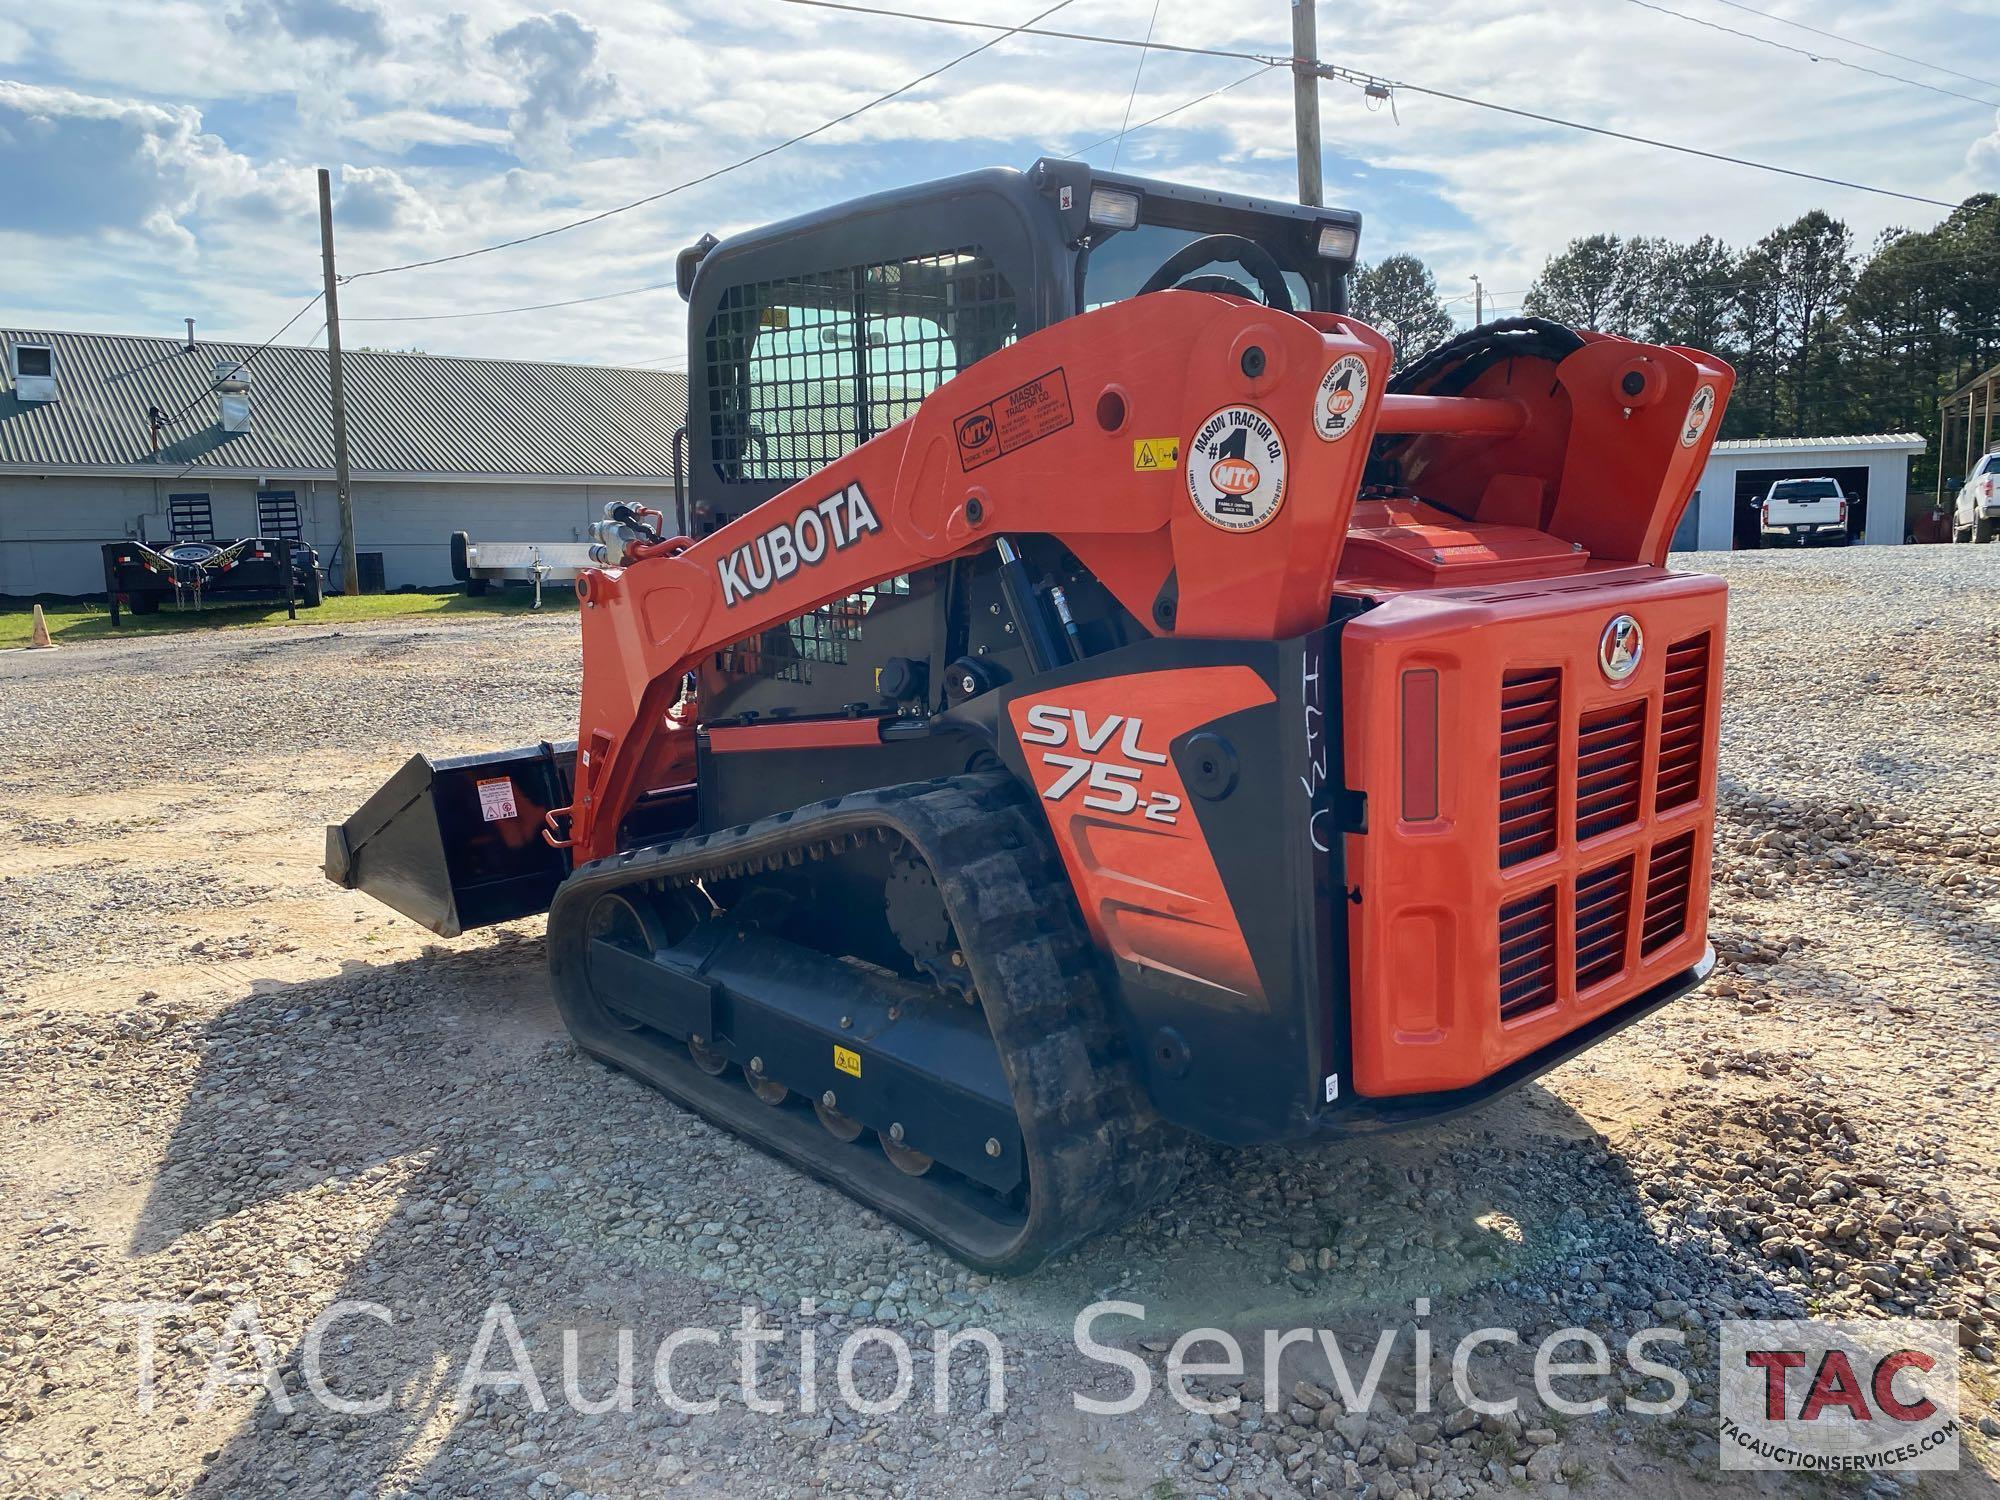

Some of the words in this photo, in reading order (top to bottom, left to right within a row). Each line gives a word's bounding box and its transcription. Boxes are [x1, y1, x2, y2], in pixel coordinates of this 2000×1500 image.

[1009, 382, 1043, 407] MASON
[1005, 398, 1038, 418] TRACTOR
[963, 418, 991, 445] MTC
[1194, 415, 1226, 454] MASON
[1228, 410, 1273, 442] TRACTOR
[1266, 440, 1282, 464] CO.
[1218, 466, 1256, 488] MTC
[1203, 511, 1237, 528] CONSTRUCTION
[214, 548, 237, 564] GATOR
[716, 482, 880, 607] KUBOTA
[1022, 704, 1168, 765] SVL
